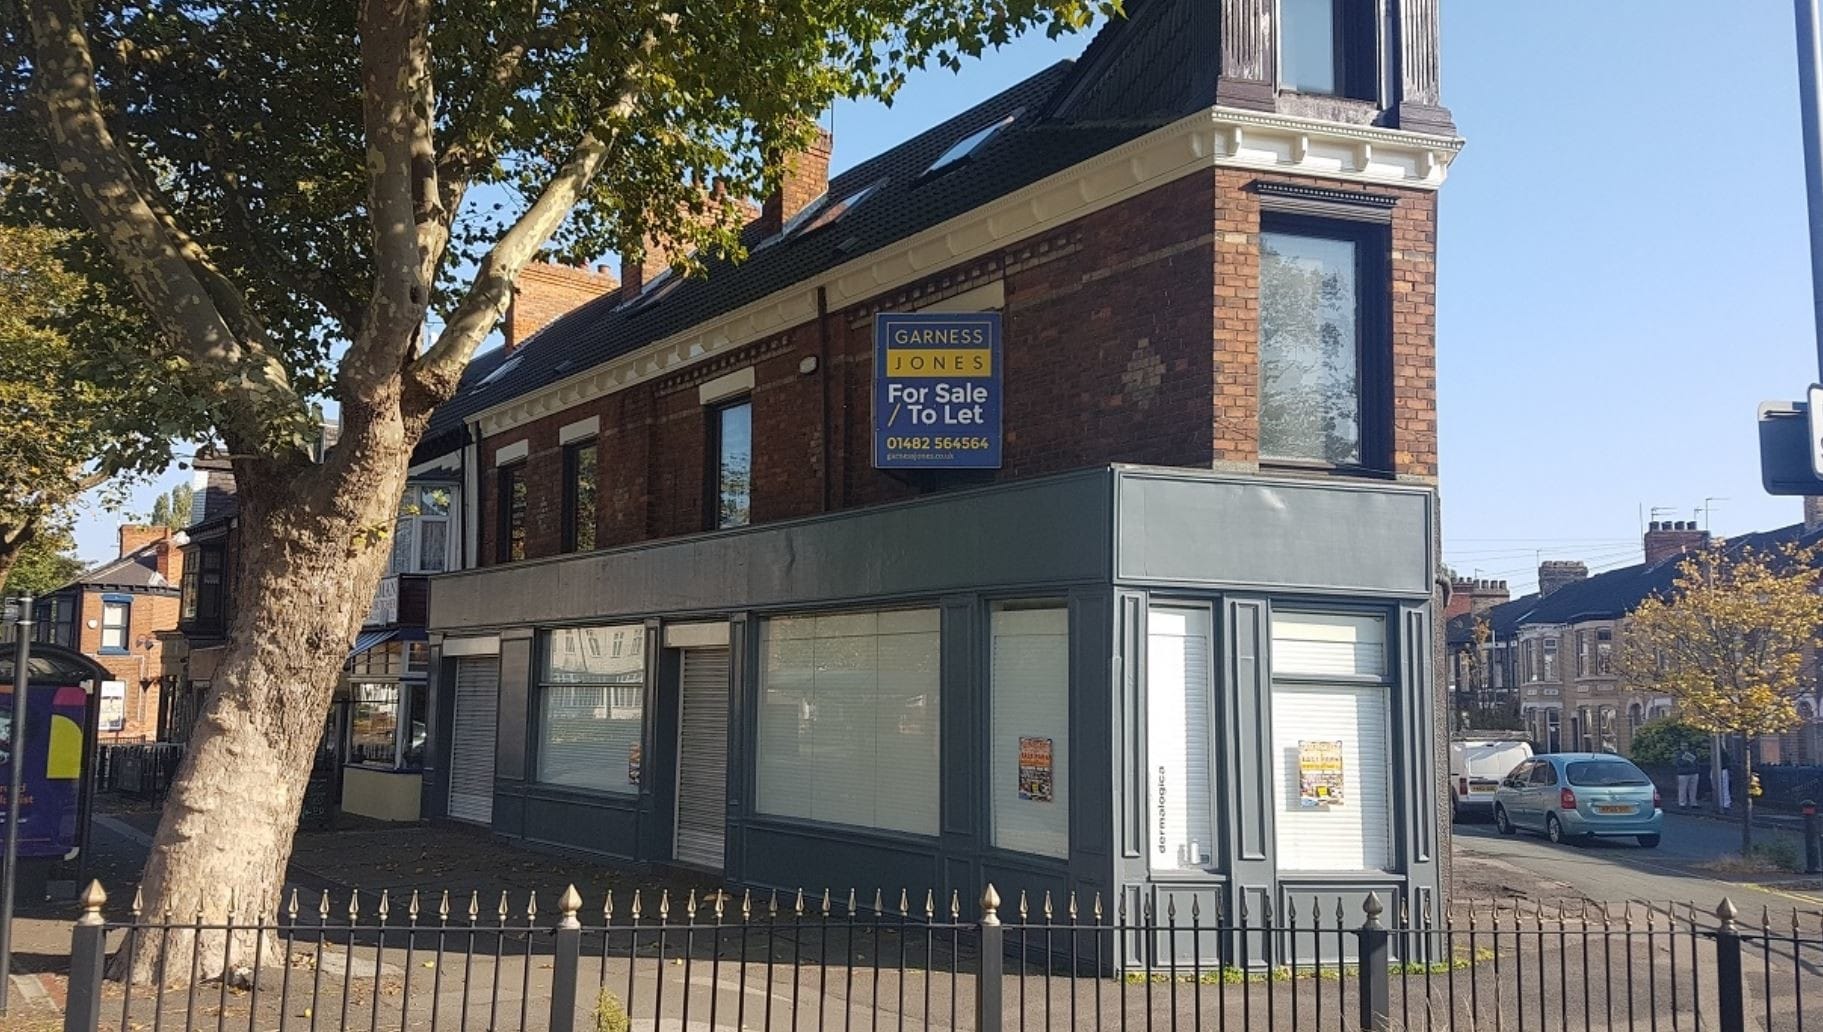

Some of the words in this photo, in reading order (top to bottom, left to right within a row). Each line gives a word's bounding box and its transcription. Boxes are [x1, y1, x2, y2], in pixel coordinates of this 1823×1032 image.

[894, 329, 984, 345] GARNESS
[894, 356, 984, 370] JONES
[888, 383, 929, 403] For
[935, 382, 988, 403] Sale
[907, 404, 937, 425] To
[944, 404, 984, 425] Let
[886, 437, 931, 449] 01482
[934, 437, 989, 450] 564564
[1158, 766, 1167, 853] dermalogica
